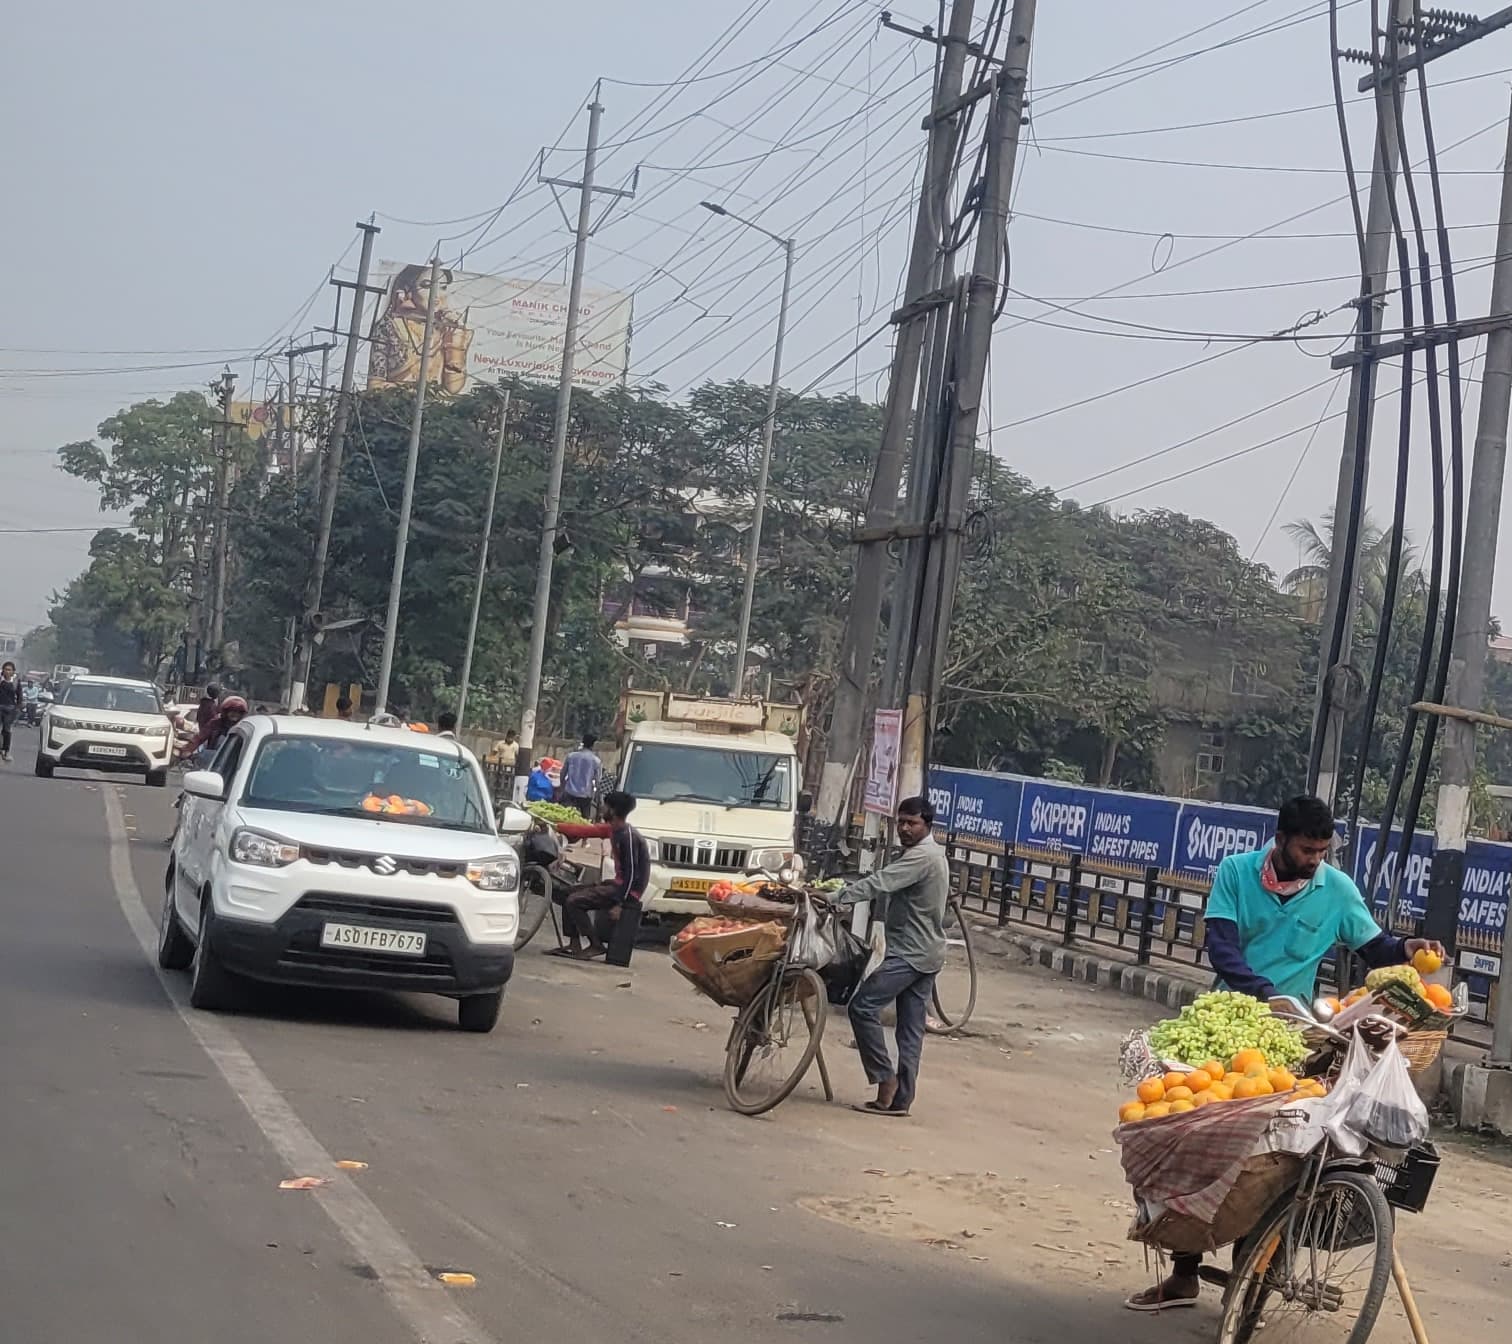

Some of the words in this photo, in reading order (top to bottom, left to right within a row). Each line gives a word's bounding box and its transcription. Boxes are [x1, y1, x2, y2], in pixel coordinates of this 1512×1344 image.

[512, 299, 548, 312] MANIK
[552, 304, 591, 316] CHND
[474, 353, 499, 366] New
[499, 357, 555, 372] Luxurious
[957, 795, 983, 814] INDIA'S
[1030, 795, 1086, 838] SKIPPER
[954, 813, 981, 832] SAFEST
[981, 818, 1003, 837] PIPES
[1094, 811, 1131, 835] INDIA'S
[1092, 835, 1130, 858] SAFEST
[1129, 840, 1159, 861] PIPES
[1462, 867, 1511, 897] INDIA'
[1458, 898, 1507, 928] SAFES
[334, 927, 424, 951] AS01FB7679
